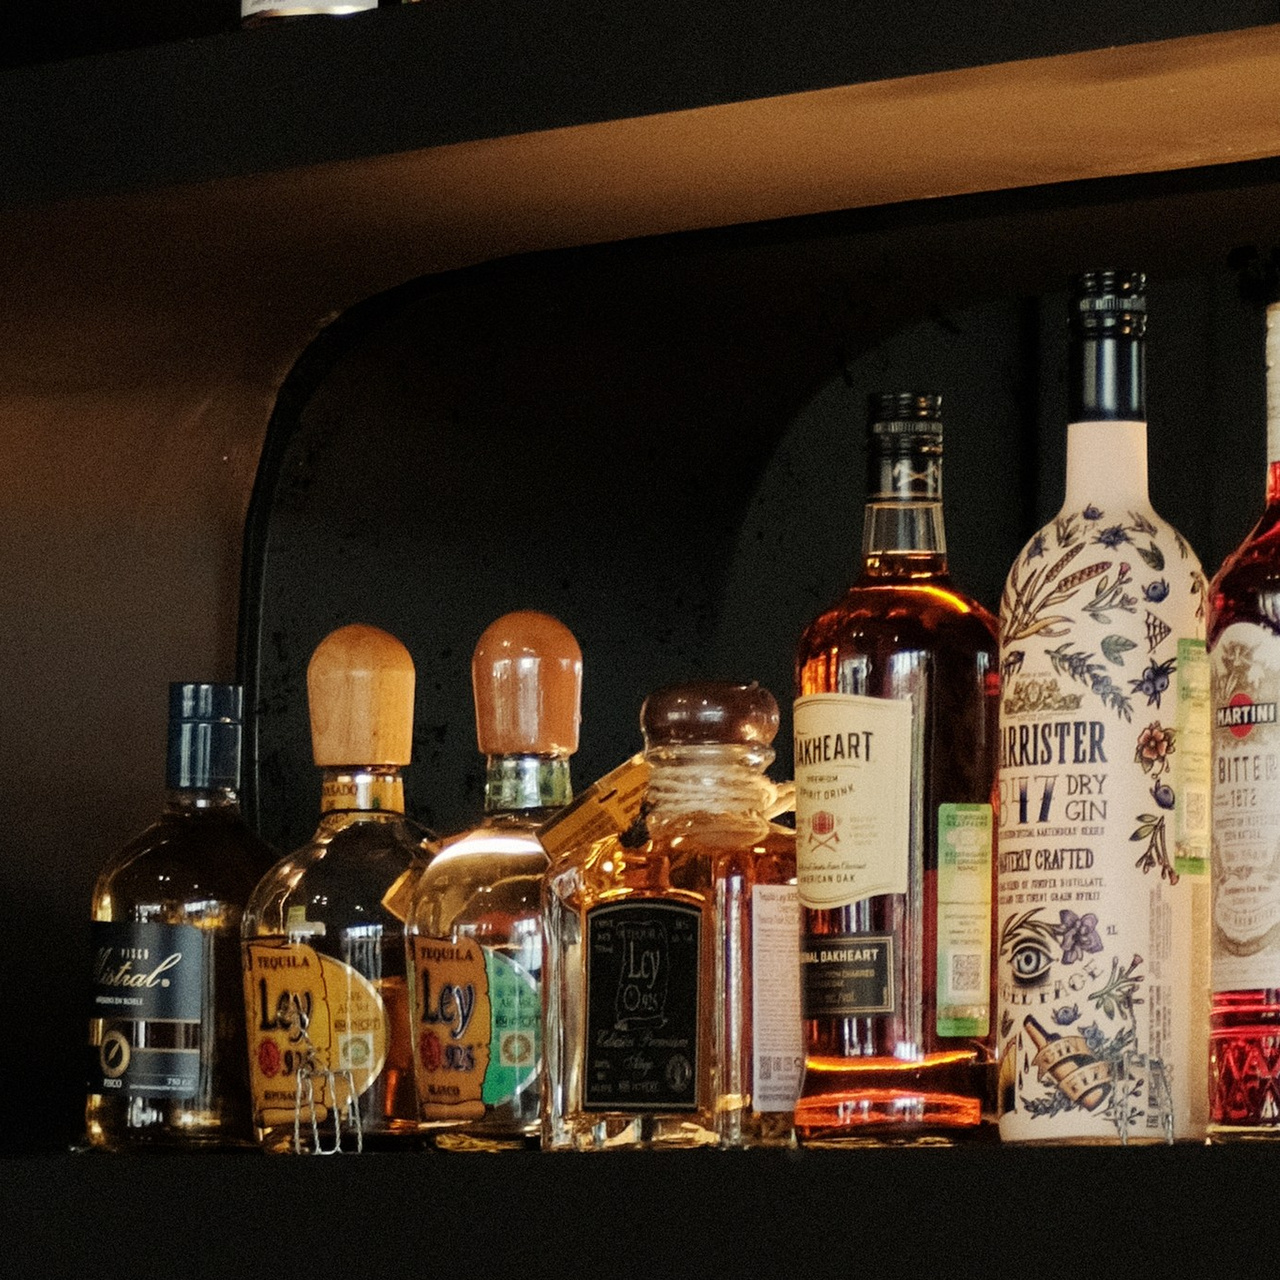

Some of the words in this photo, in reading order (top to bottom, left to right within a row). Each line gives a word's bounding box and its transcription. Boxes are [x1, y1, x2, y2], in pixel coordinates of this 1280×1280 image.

[1217, 704, 1276, 727] MARTINI
[824, 783, 854, 800] DRINK
[1067, 774, 1108, 796] DRY
[1065, 800, 1107, 822] GIN
[1035, 847, 1094, 871] CRAFTED
[257, 955, 310, 970] TEQUILA
[421, 947, 474, 961] TEQUILA
[821, 948, 879, 962] OAKHEART
[260, 977, 313, 1043] Ley
[422, 969, 475, 1040] Ley
